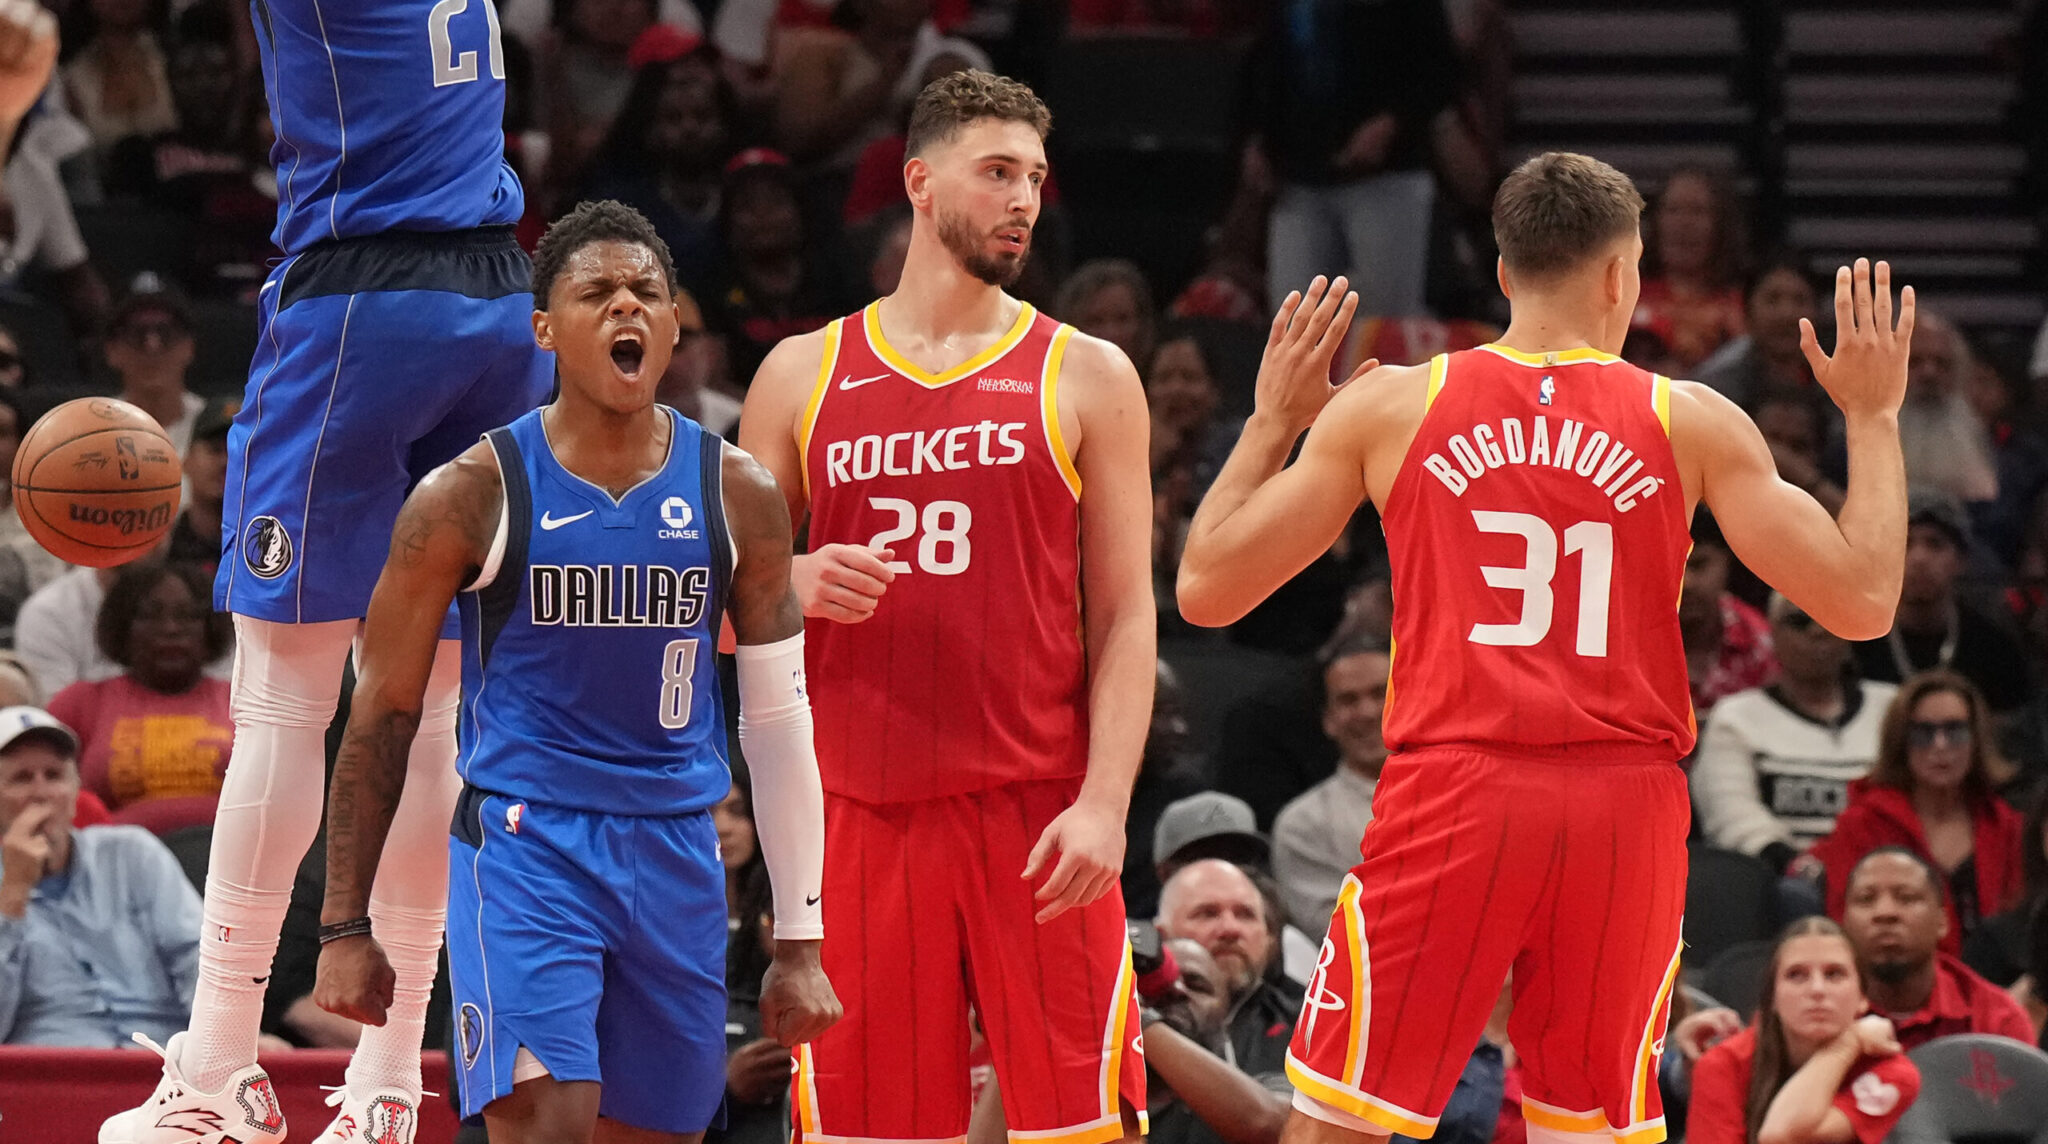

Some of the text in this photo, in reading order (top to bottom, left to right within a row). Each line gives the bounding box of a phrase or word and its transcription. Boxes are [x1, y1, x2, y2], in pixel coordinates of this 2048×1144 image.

[977, 383, 1034, 394] HERMANN
[978, 378, 1033, 389] MEMORIAL
[1423, 415, 1666, 513] BOGDANOVIĆ
[69, 501, 171, 536] Wilson
[658, 529, 700, 540] CHASE
[868, 497, 972, 576] 28
[530, 564, 710, 628] DALLAS
[1467, 509, 1614, 658] 31
[658, 638, 700, 729] 8
